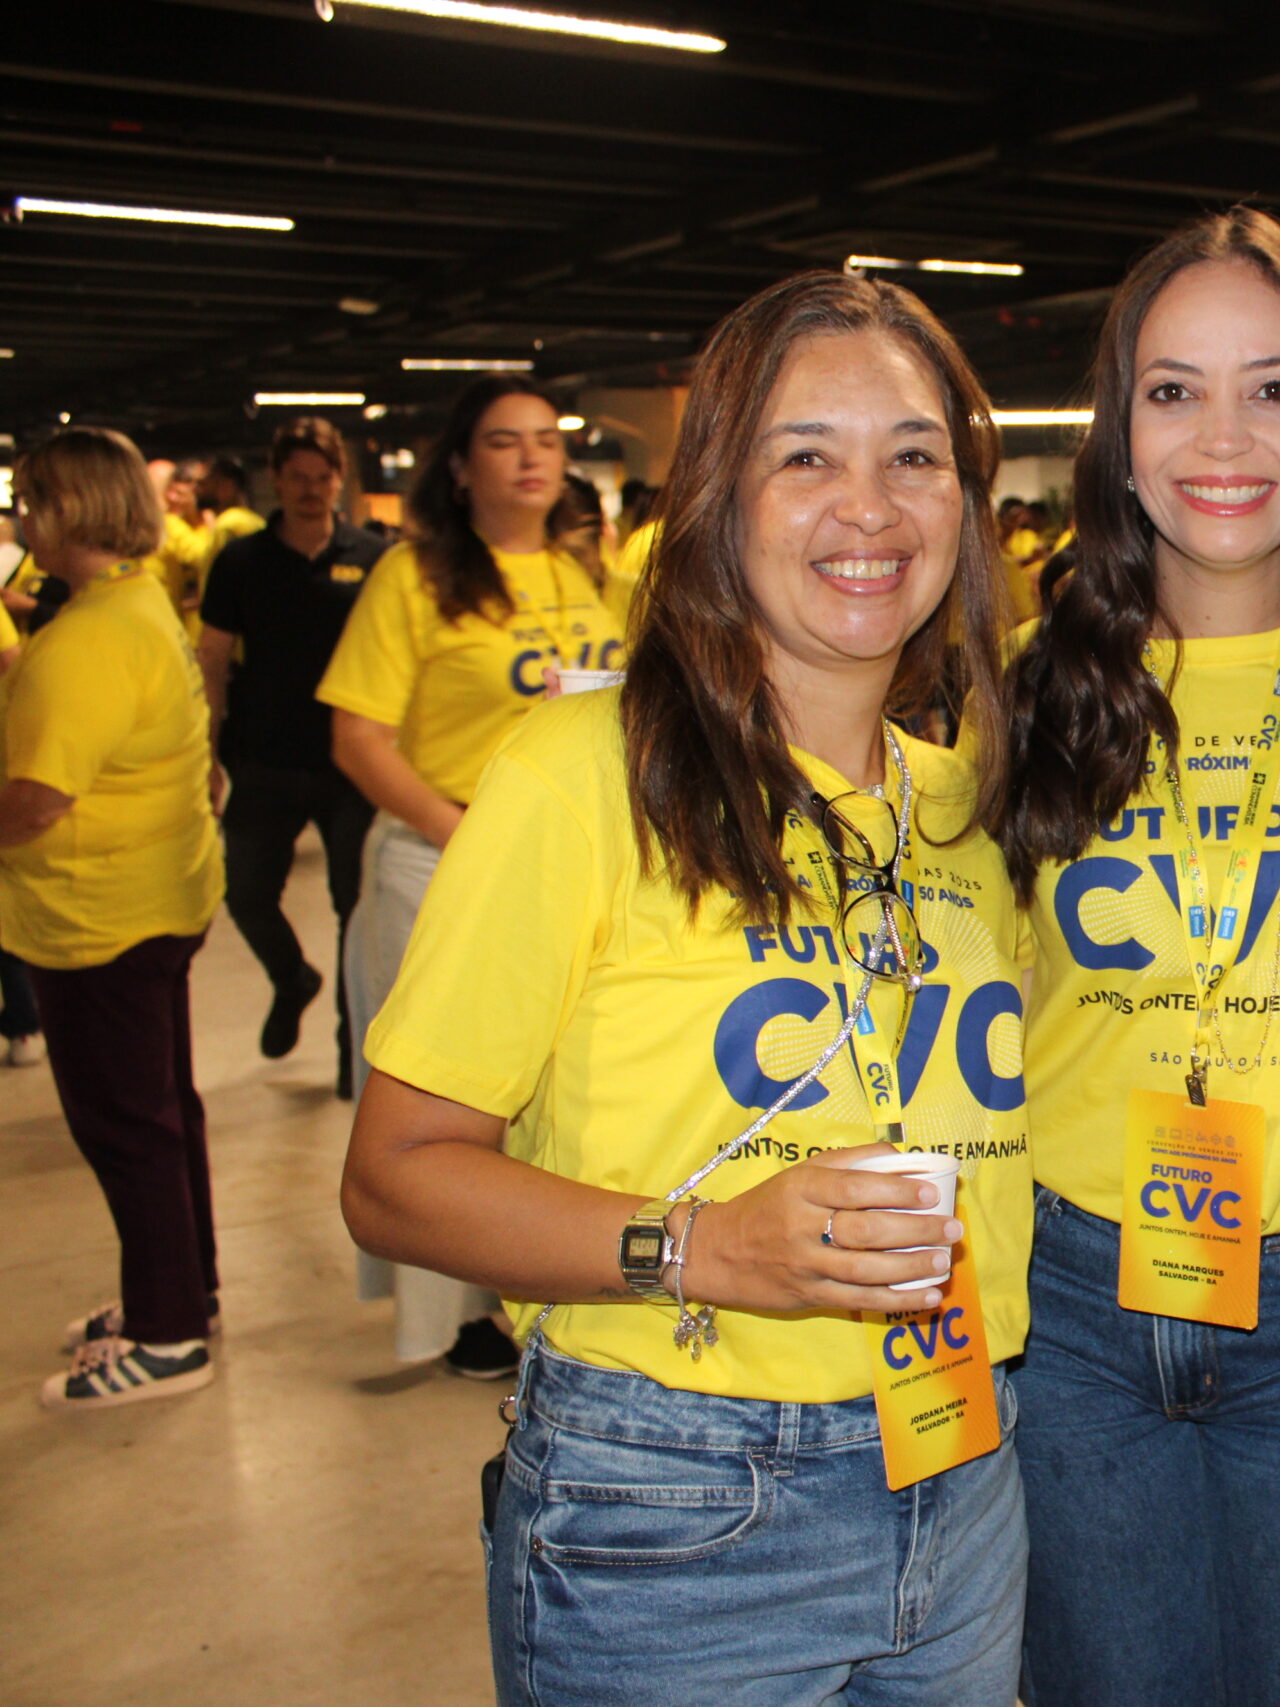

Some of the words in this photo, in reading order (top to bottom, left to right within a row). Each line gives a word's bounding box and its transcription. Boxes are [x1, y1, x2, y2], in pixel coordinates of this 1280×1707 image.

[1195, 736, 1220, 748] DE
[1256, 714, 1278, 751] CVC
[918, 886, 935, 901] 50
[938, 888, 975, 909] ANOS
[1076, 989, 1134, 1015] JUNTOS
[1224, 995, 1280, 1014] HOJE
[1150, 1051, 1183, 1066] SÃO
[866, 1062, 890, 1107] CVC
[953, 1143, 964, 1161] E
[965, 1133, 1028, 1160] AMANHÃ
[1151, 1163, 1213, 1184] FUTURO
[1140, 1180, 1242, 1229] CVC
[1138, 1224, 1163, 1232] JUNTOS
[1152, 1259, 1180, 1270] DIANA
[1182, 1264, 1225, 1277] MARQUES
[1158, 1270, 1199, 1283] SALVADOR
[883, 1307, 970, 1371] CVC
[889, 1378, 911, 1392] JUNTOS
[909, 1406, 945, 1426] JORDANA
[945, 1397, 968, 1412] MEIRA
[915, 1416, 950, 1435] SALVADOR
[955, 1410, 965, 1420] BA
